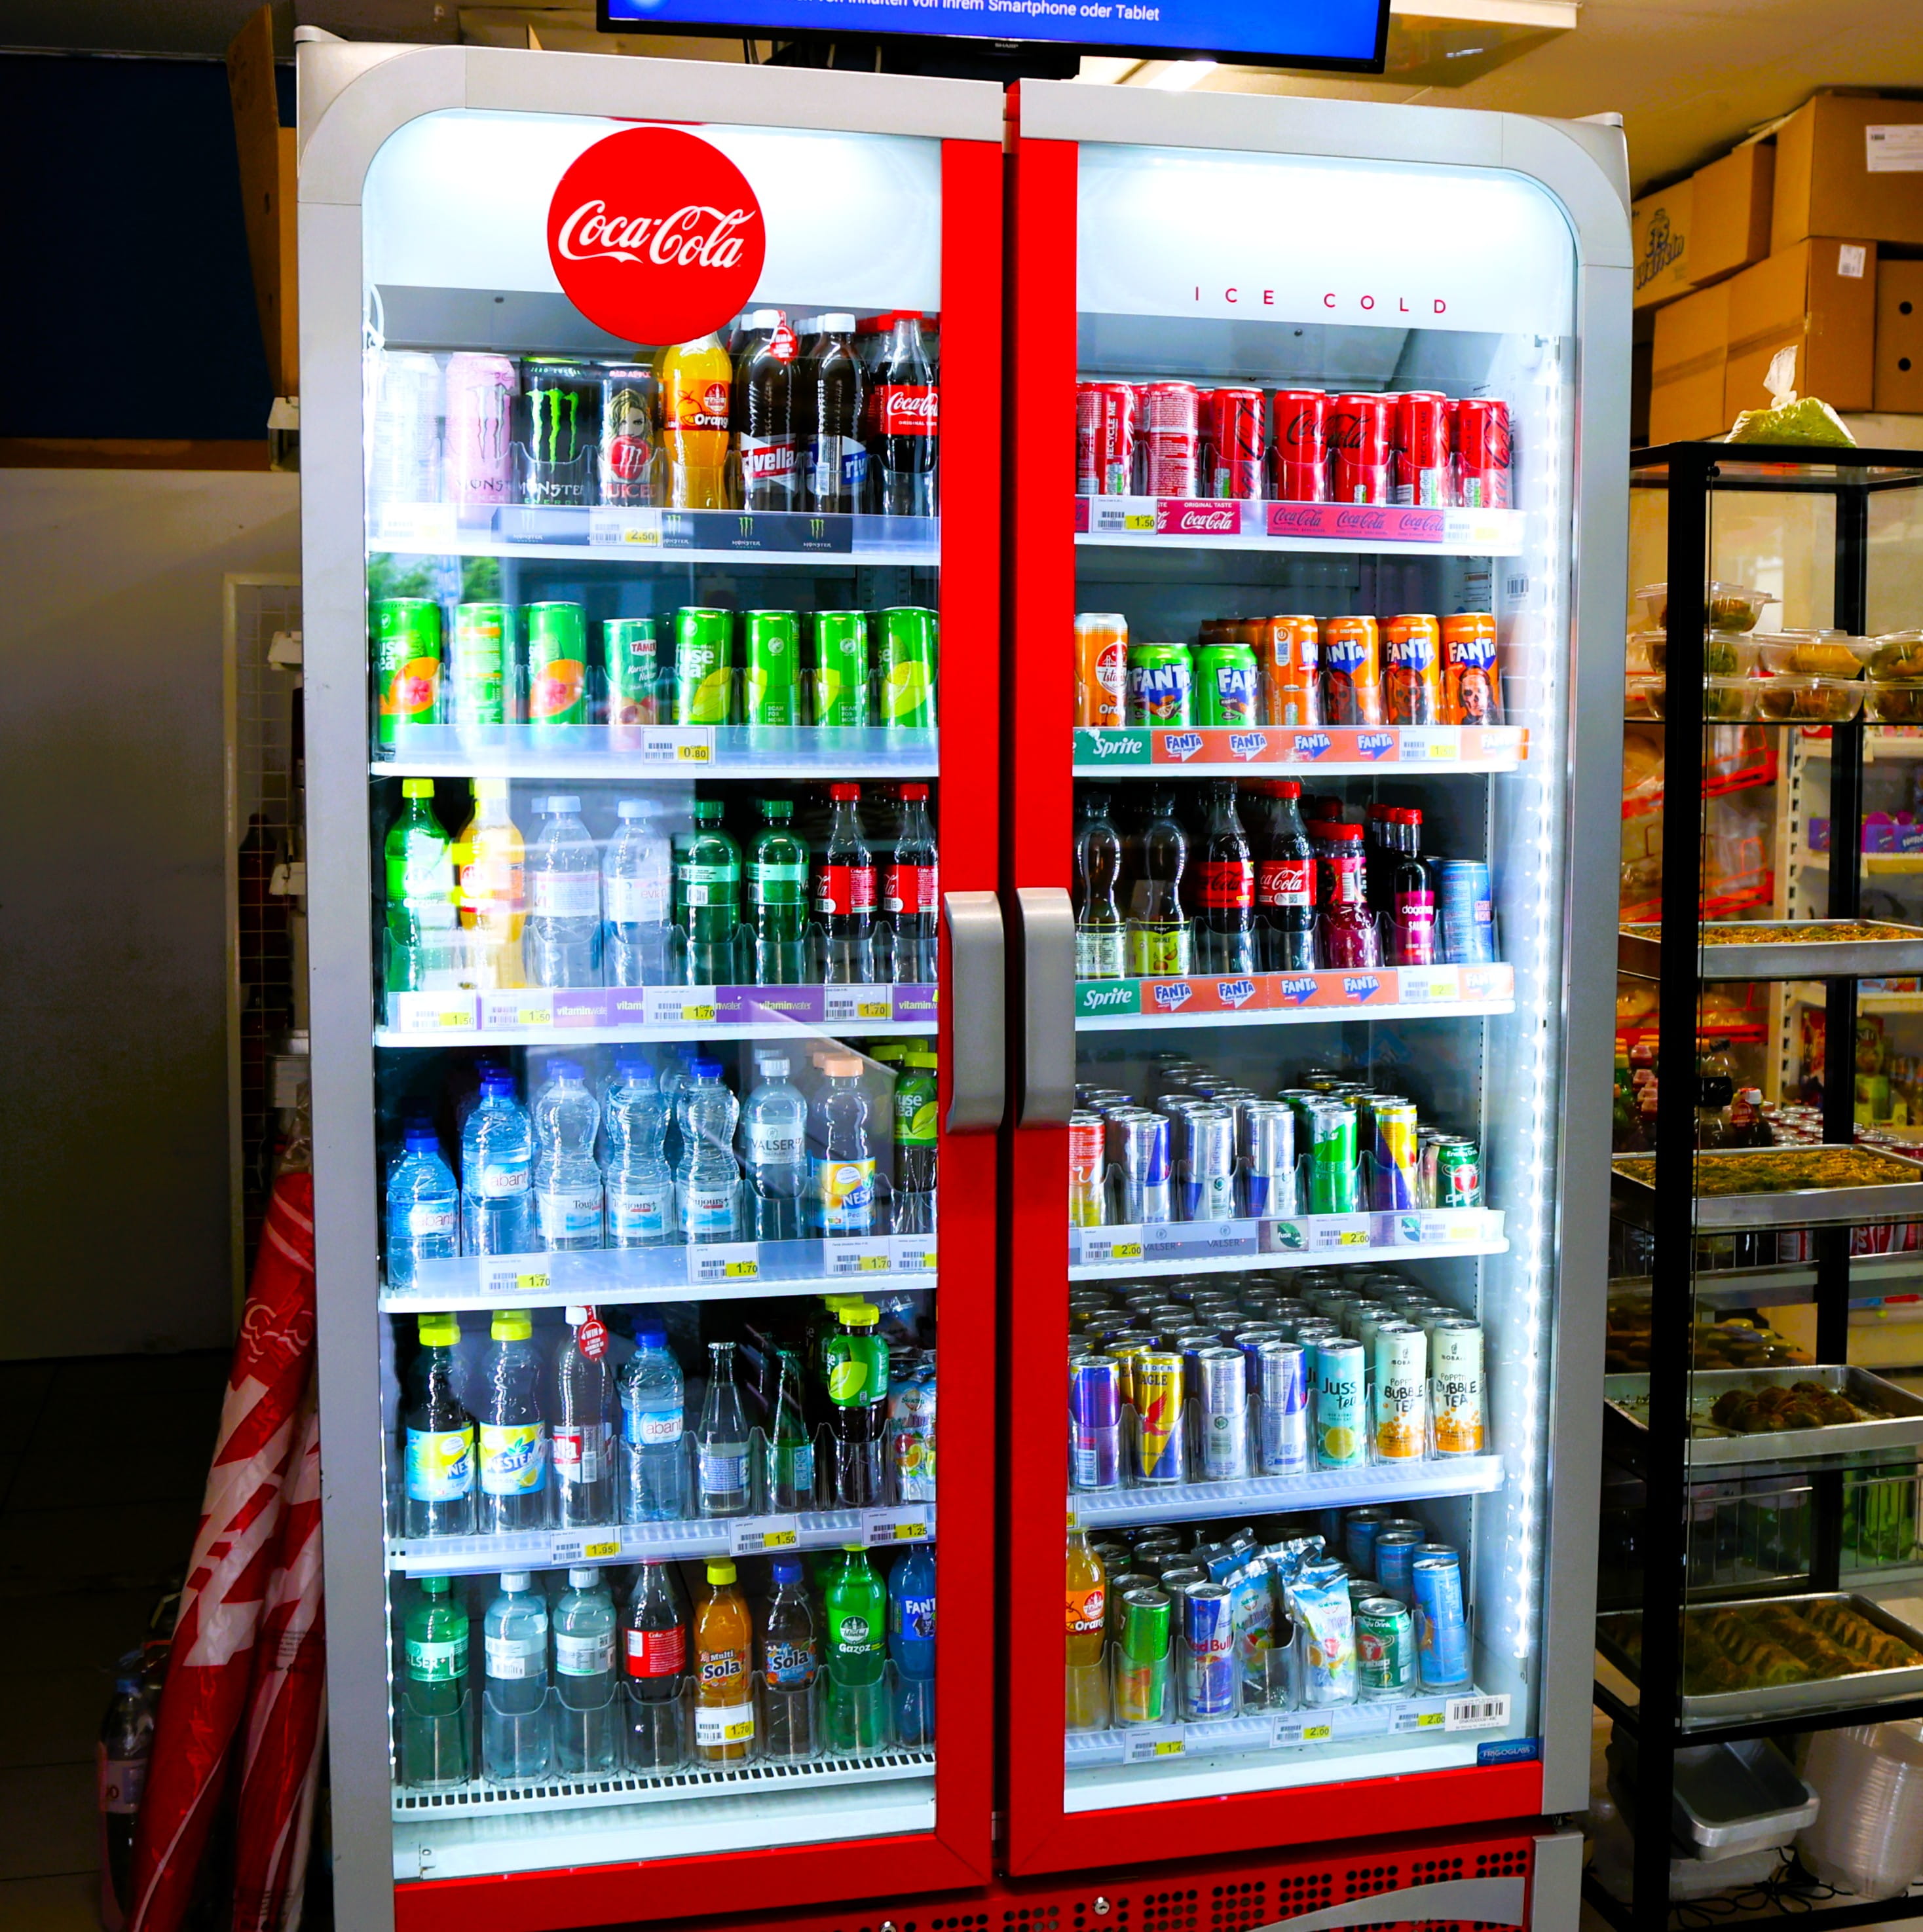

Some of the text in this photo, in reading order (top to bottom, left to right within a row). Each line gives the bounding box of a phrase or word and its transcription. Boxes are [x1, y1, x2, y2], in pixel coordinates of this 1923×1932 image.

[988, 0, 1076, 17] Smartphone
[1080, 4, 1112, 18] oder
[1115, 5, 1160, 22] Tablet
[558, 199, 756, 268] Coca-Cola
[1195, 286, 1447, 314] ICE COLD
[1107, 401, 1116, 459] RECYCLE ME
[1134, 515, 1155, 528] 1.50
[1180, 510, 1235, 530] Coca-Cola
[1273, 507, 1324, 528] Coca-Cola
[1336, 510, 1388, 530] Coca-Cola
[630, 529, 655, 540] 2.50
[1447, 638, 1495, 663] FANTA
[1218, 665, 1258, 694] FAN
[1092, 737, 1143, 758] Sprite
[1166, 734, 1203, 749] FANTA
[1230, 734, 1266, 749] FANTA
[1294, 734, 1331, 750] FANTA
[1357, 734, 1394, 749] FANTA
[683, 747, 707, 758] 0.80
[1155, 982, 1191, 999] FANTA
[1219, 980, 1254, 997] FANTA
[1282, 976, 1318, 992] FANTA
[1343, 976, 1380, 992] FANTA
[616, 1000, 643, 1011] vitami
[759, 999, 812, 1011] vitaminwater
[1083, 988, 1132, 1009] Sprite
[529, 1011, 551, 1022] 1.50
[694, 1007, 715, 1018] 1.70
[863, 1004, 886, 1015] 1.70
[751, 1138, 795, 1151] VALSER
[491, 1171, 527, 1188] abant
[1206, 1238, 1240, 1248] VALSER
[1350, 1233, 1370, 1244] 2.00
[1121, 1244, 1142, 1255] 2.00
[736, 1263, 758, 1274] 1.70
[870, 1258, 891, 1269] 1.70
[529, 1276, 551, 1287] 1.70
[1322, 1377, 1357, 1396] Juss
[1443, 1394, 1468, 1408] TEA
[646, 1419, 682, 1436] abant
[449, 1459, 470, 1476] NES
[906, 1526, 928, 1536] 1.25
[775, 1534, 796, 1545] 1.50
[591, 1544, 614, 1556] 1.95
[905, 1597, 935, 1615] FANT
[838, 1643, 870, 1654] Gazoz
[1210, 1637, 1232, 1652] Bull
[710, 1650, 734, 1662] Multi
[772, 1648, 809, 1670] Sola
[703, 1660, 741, 1680] Sola
[1427, 1715, 1446, 1725] 2.00
[730, 1724, 749, 1736] 1.70
[1309, 1727, 1330, 1737] 2.00
[1167, 1743, 1186, 1753] 1.40
[1483, 1746, 1531, 1758] FRIGOGLASS
